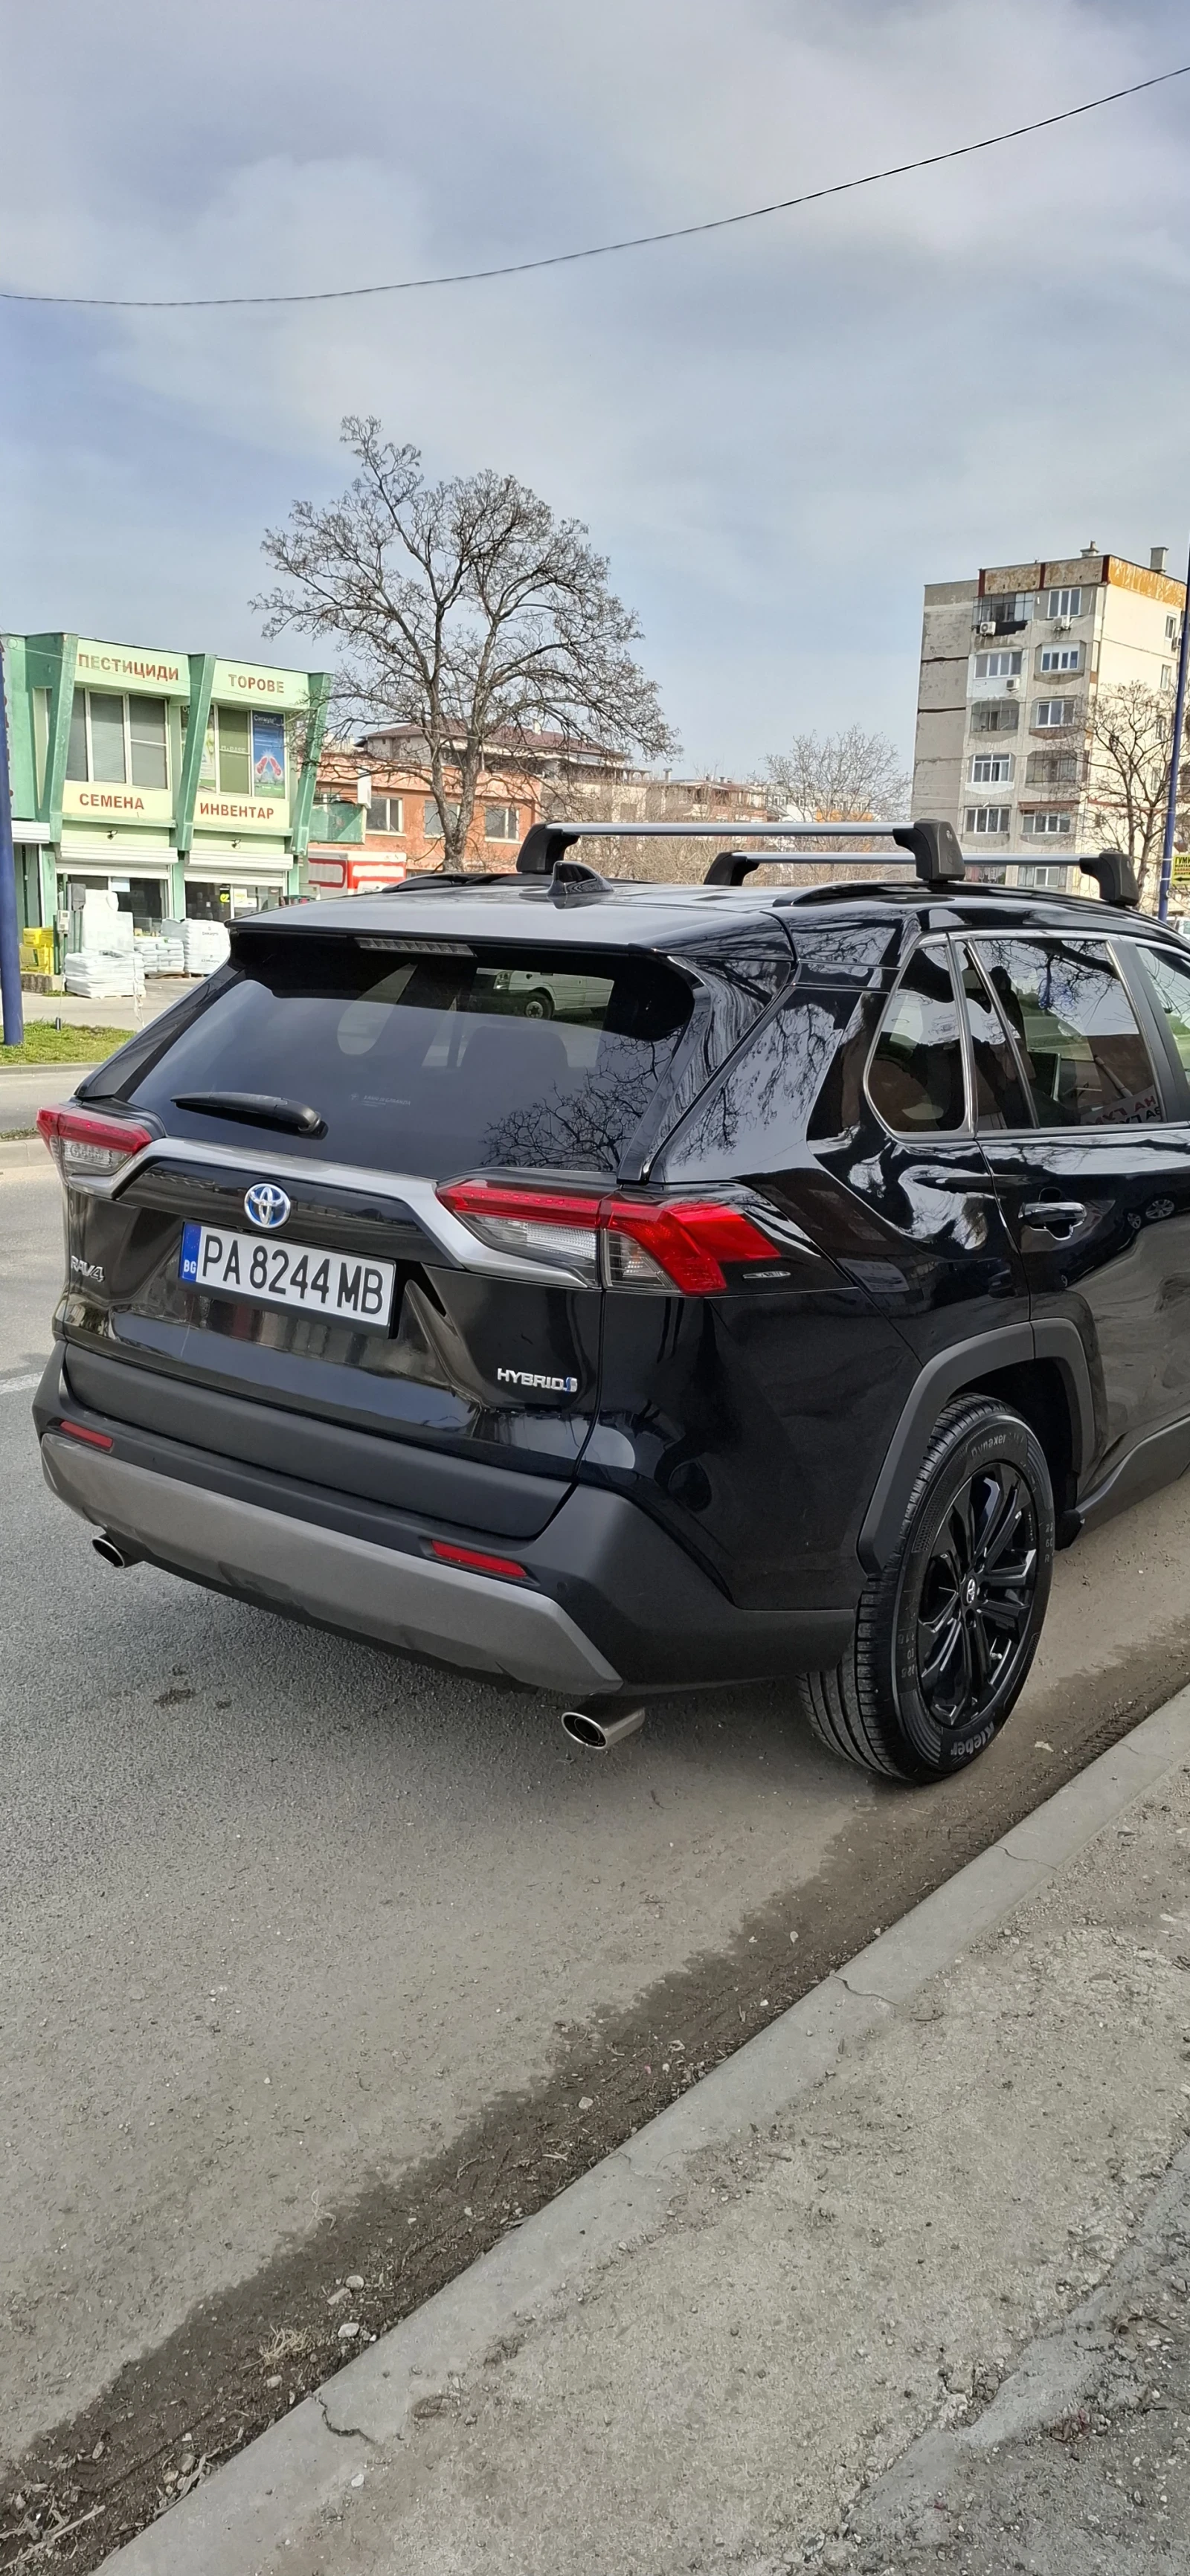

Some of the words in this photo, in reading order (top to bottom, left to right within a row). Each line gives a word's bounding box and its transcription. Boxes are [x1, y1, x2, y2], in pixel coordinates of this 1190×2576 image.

[78, 653, 179, 682] ПЕСТИЦИДИ
[228, 674, 285, 694] ТОРОВЕ
[79, 793, 145, 811] СЕМЕНА
[199, 802, 274, 820] ИНВЕНТАР
[71, 1255, 105, 1283] RAV4
[183, 1259, 197, 1274] BG
[202, 1234, 240, 1285] PA
[249, 1245, 330, 1304] 8244
[337, 1261, 384, 1315] MB
[497, 1368, 564, 1391] HYBRID
[951, 1721, 995, 1756] Kleber
